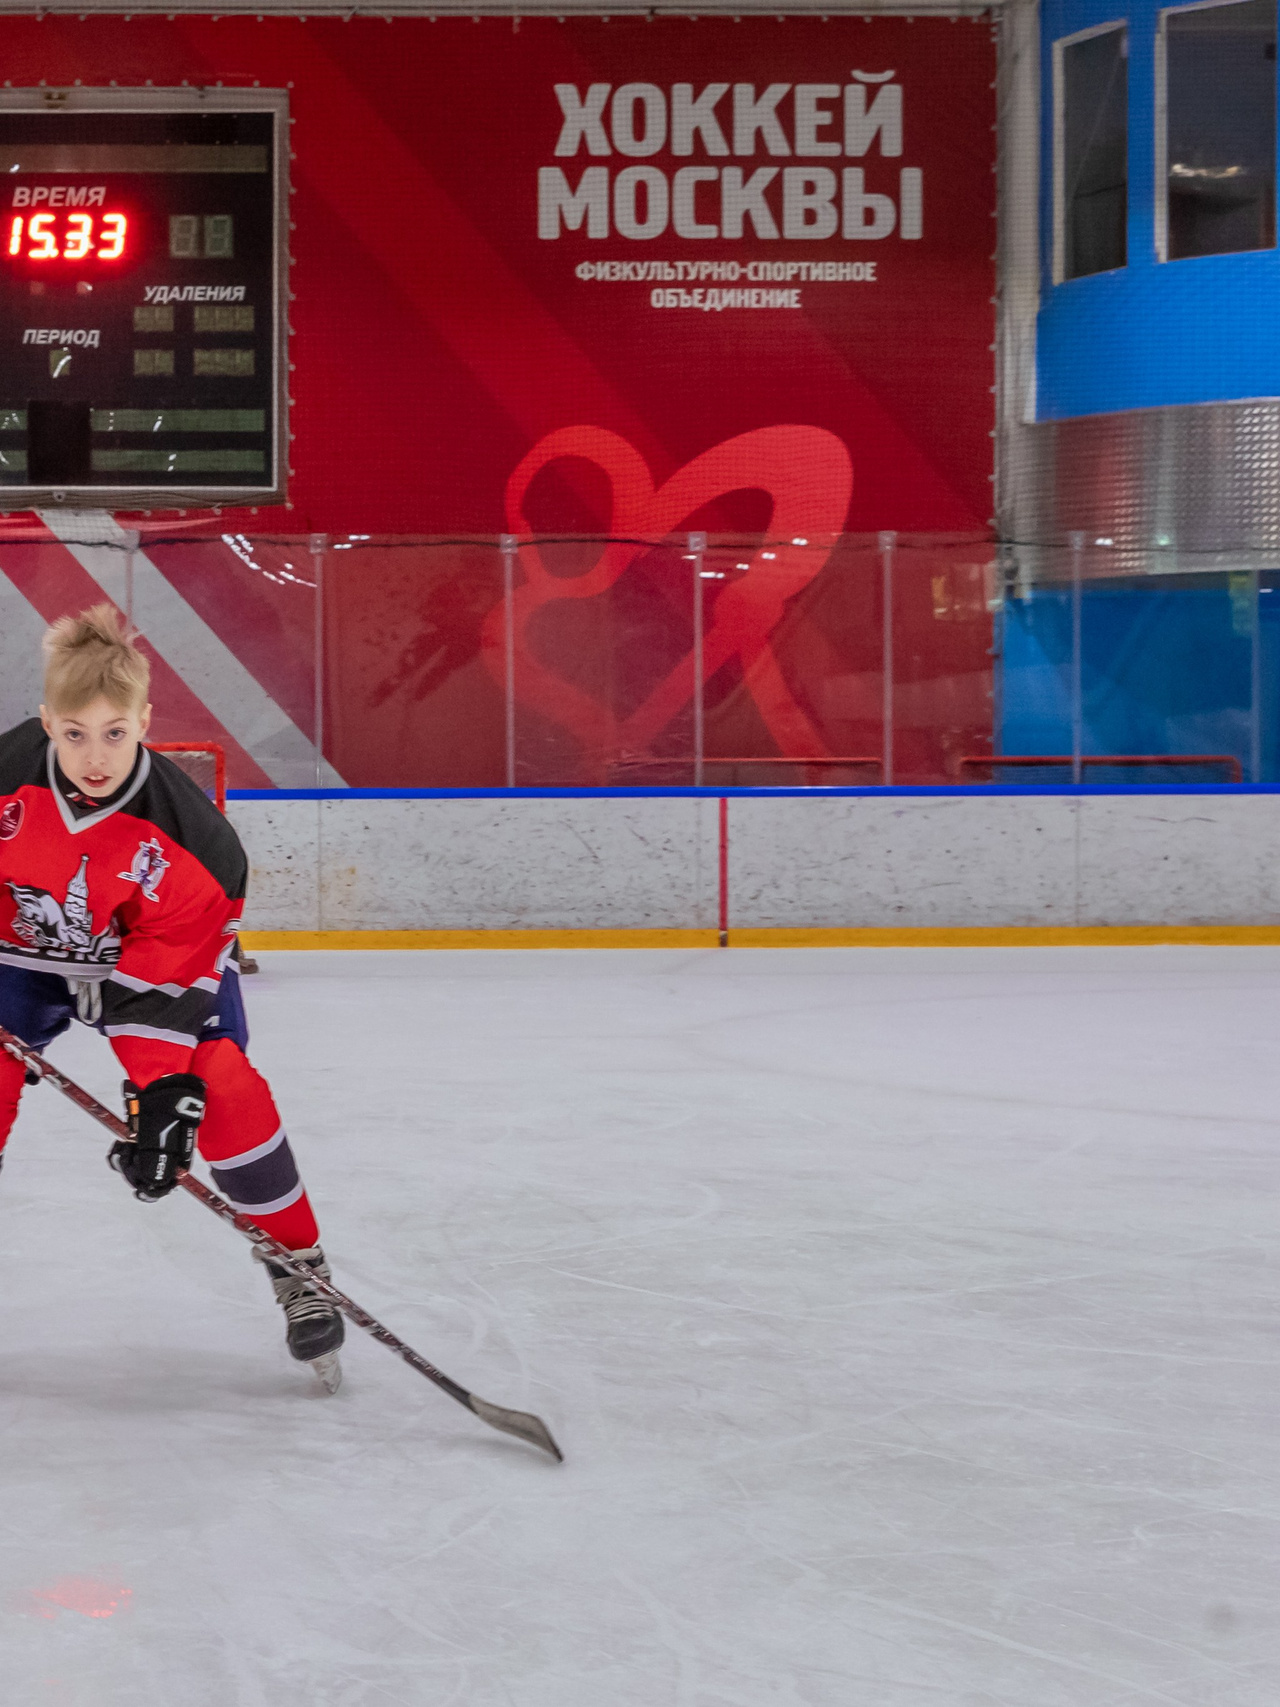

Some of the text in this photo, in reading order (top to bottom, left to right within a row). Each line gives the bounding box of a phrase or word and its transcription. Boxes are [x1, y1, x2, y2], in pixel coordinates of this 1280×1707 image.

[553, 69, 904, 158] ХОККЕЙ
[11, 186, 107, 208] ВРЕМЯ
[537, 165, 924, 241] МОСКВЫ
[575, 261, 878, 282] ФИЗКУЛЬТУРНО-СПОРТИВНОЕ
[143, 285, 246, 302] УДАЛЕНИЯ
[650, 288, 803, 312] ОБЪЕДИНЕНИЕ
[22, 329, 101, 349] ПЕРИОД
